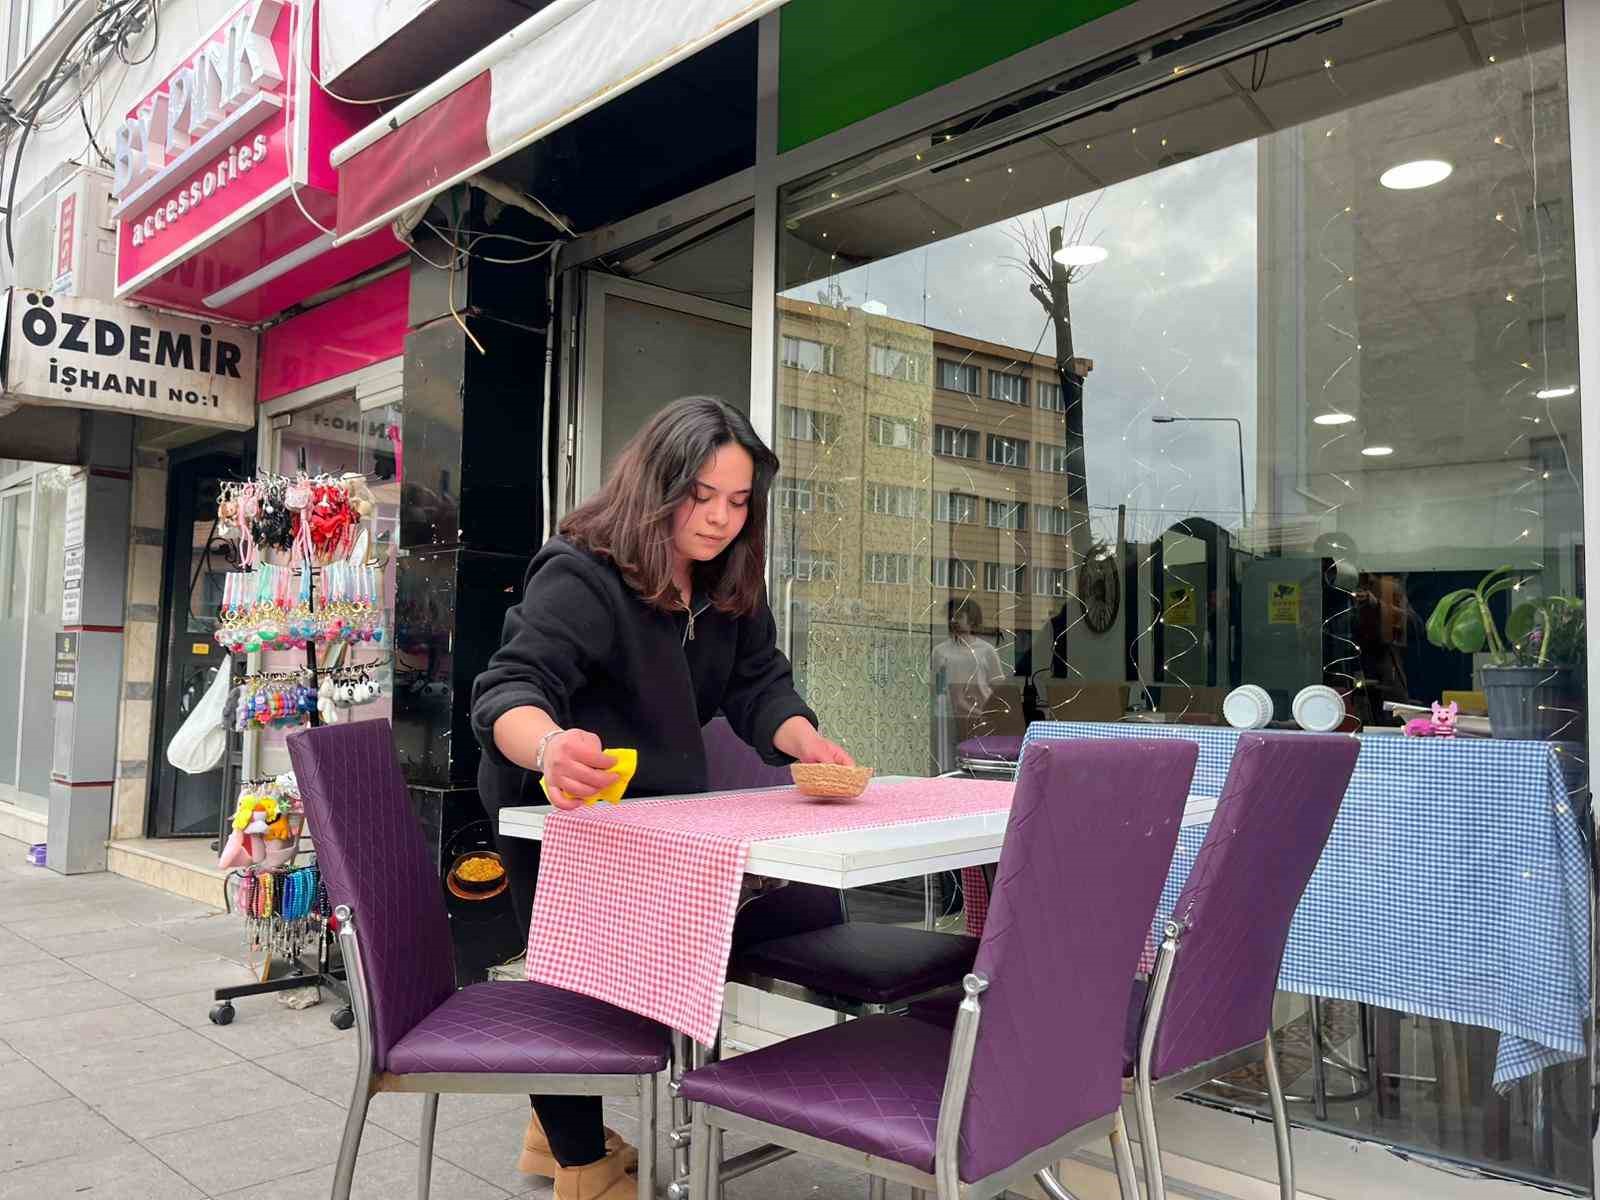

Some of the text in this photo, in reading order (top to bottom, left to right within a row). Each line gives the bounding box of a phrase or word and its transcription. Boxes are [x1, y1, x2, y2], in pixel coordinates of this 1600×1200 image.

[131, 134, 268, 247] accessories
[22, 292, 242, 379] ÖZDEMİR
[49, 357, 219, 408] İŞHANI NO:1
